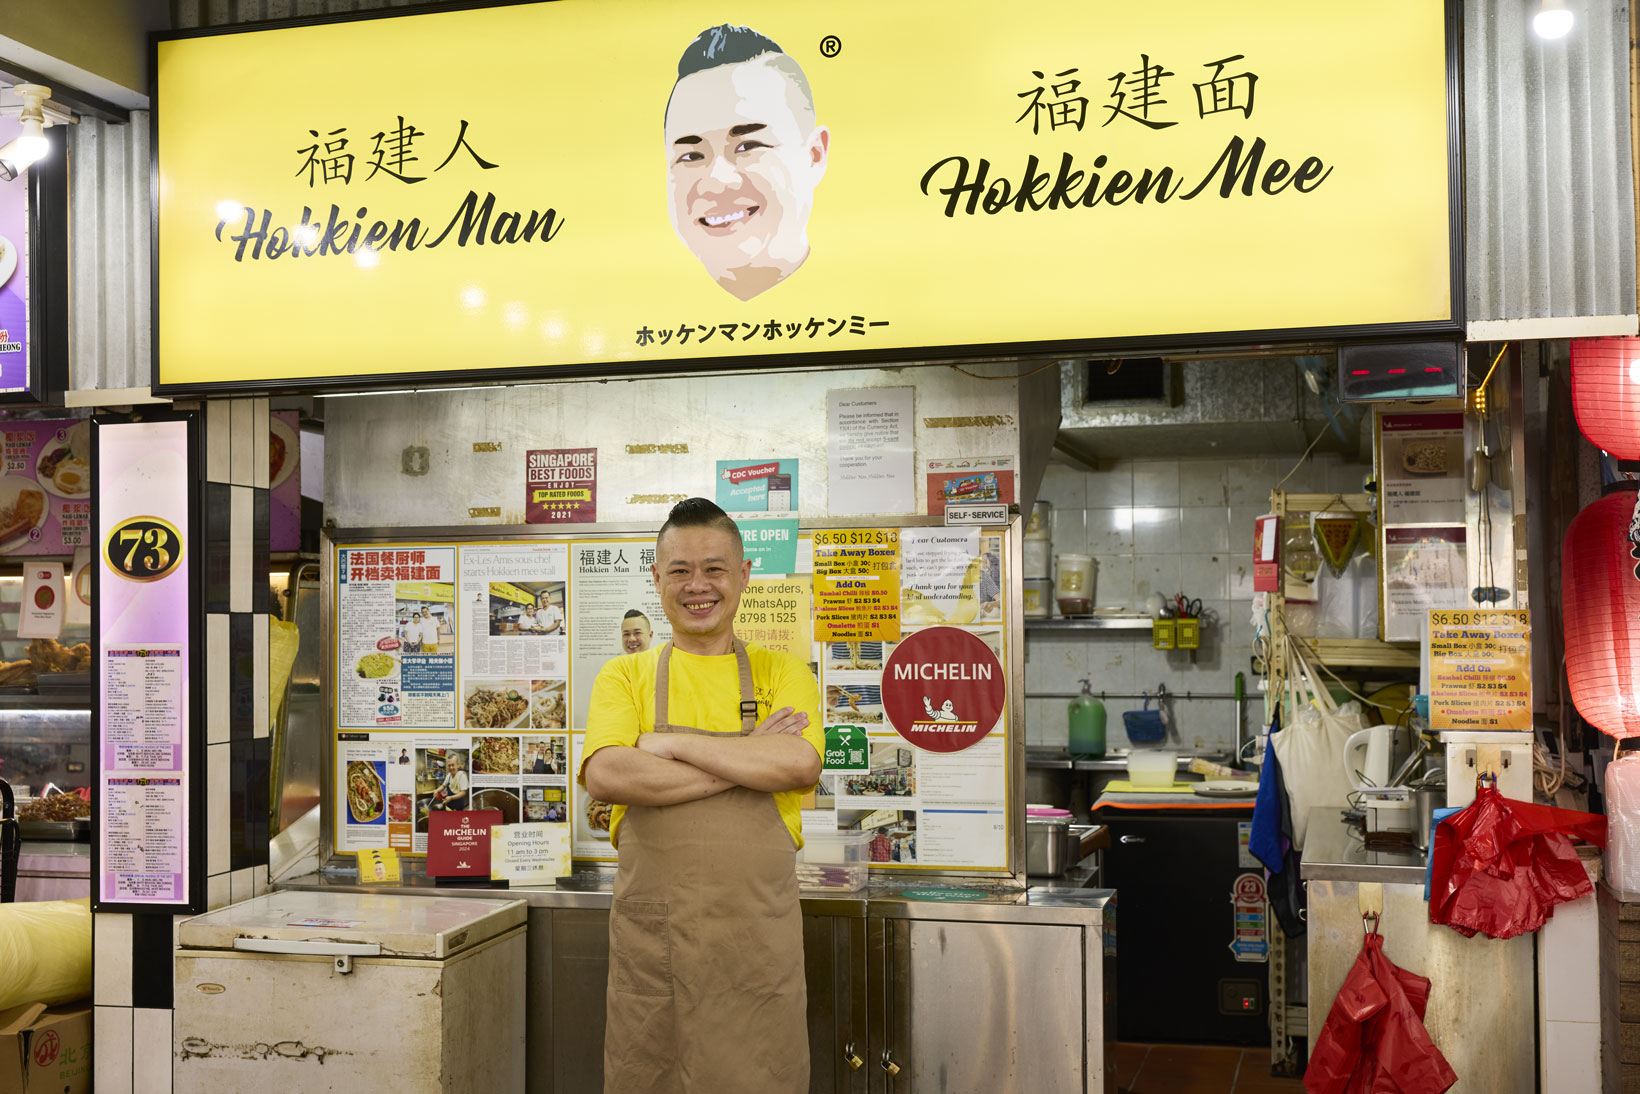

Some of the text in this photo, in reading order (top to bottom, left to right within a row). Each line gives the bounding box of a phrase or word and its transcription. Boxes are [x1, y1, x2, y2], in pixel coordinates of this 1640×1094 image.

[1015, 54, 1260, 135] 福建面
[295, 115, 500, 188] 福建人
[920, 135, 1334, 218] Hokkien Mee
[215, 190, 566, 263] Hokkien Man
[635, 315, 889, 347] ホッケンマンホッケンミー
[7, 462, 24, 470] $2.50
[529, 453, 594, 467] SINGAPORE
[530, 468, 592, 480] BEST FOODS
[731, 467, 775, 479] CDC Voucher
[730, 484, 765, 496] Accepted
[748, 493, 765, 502] here
[761, 529, 789, 541] OPEN
[815, 532, 898, 545] $6.50 $12 $18
[931, 536, 968, 544] Customers
[119, 528, 170, 571] 73
[840, 549, 866, 558] Away
[350, 551, 425, 566] 法国餐厨师
[464, 555, 492, 565] Ex-Les
[494, 555, 513, 564] Amis
[534, 554, 551, 564] chef
[580, 549, 629, 565] 福建人
[351, 566, 441, 581] 开档卖福建面
[464, 569, 485, 577] starts
[487, 566, 520, 576] Hokkien
[541, 566, 556, 575] stall
[579, 566, 609, 574] Hokkien
[767, 584, 804, 595] orders,
[742, 599, 797, 610] WhatsApp
[740, 613, 796, 623] 8798 1525
[1432, 613, 1527, 626] $6.50 $12 $18
[1432, 631, 1525, 640] Take Away Boxes
[894, 664, 992, 680] MICHELIN
[1456, 665, 1491, 673] Add On
[911, 725, 977, 733] MICHELIN
[826, 757, 846, 765] Food
[514, 831, 544, 839] 营业时间
